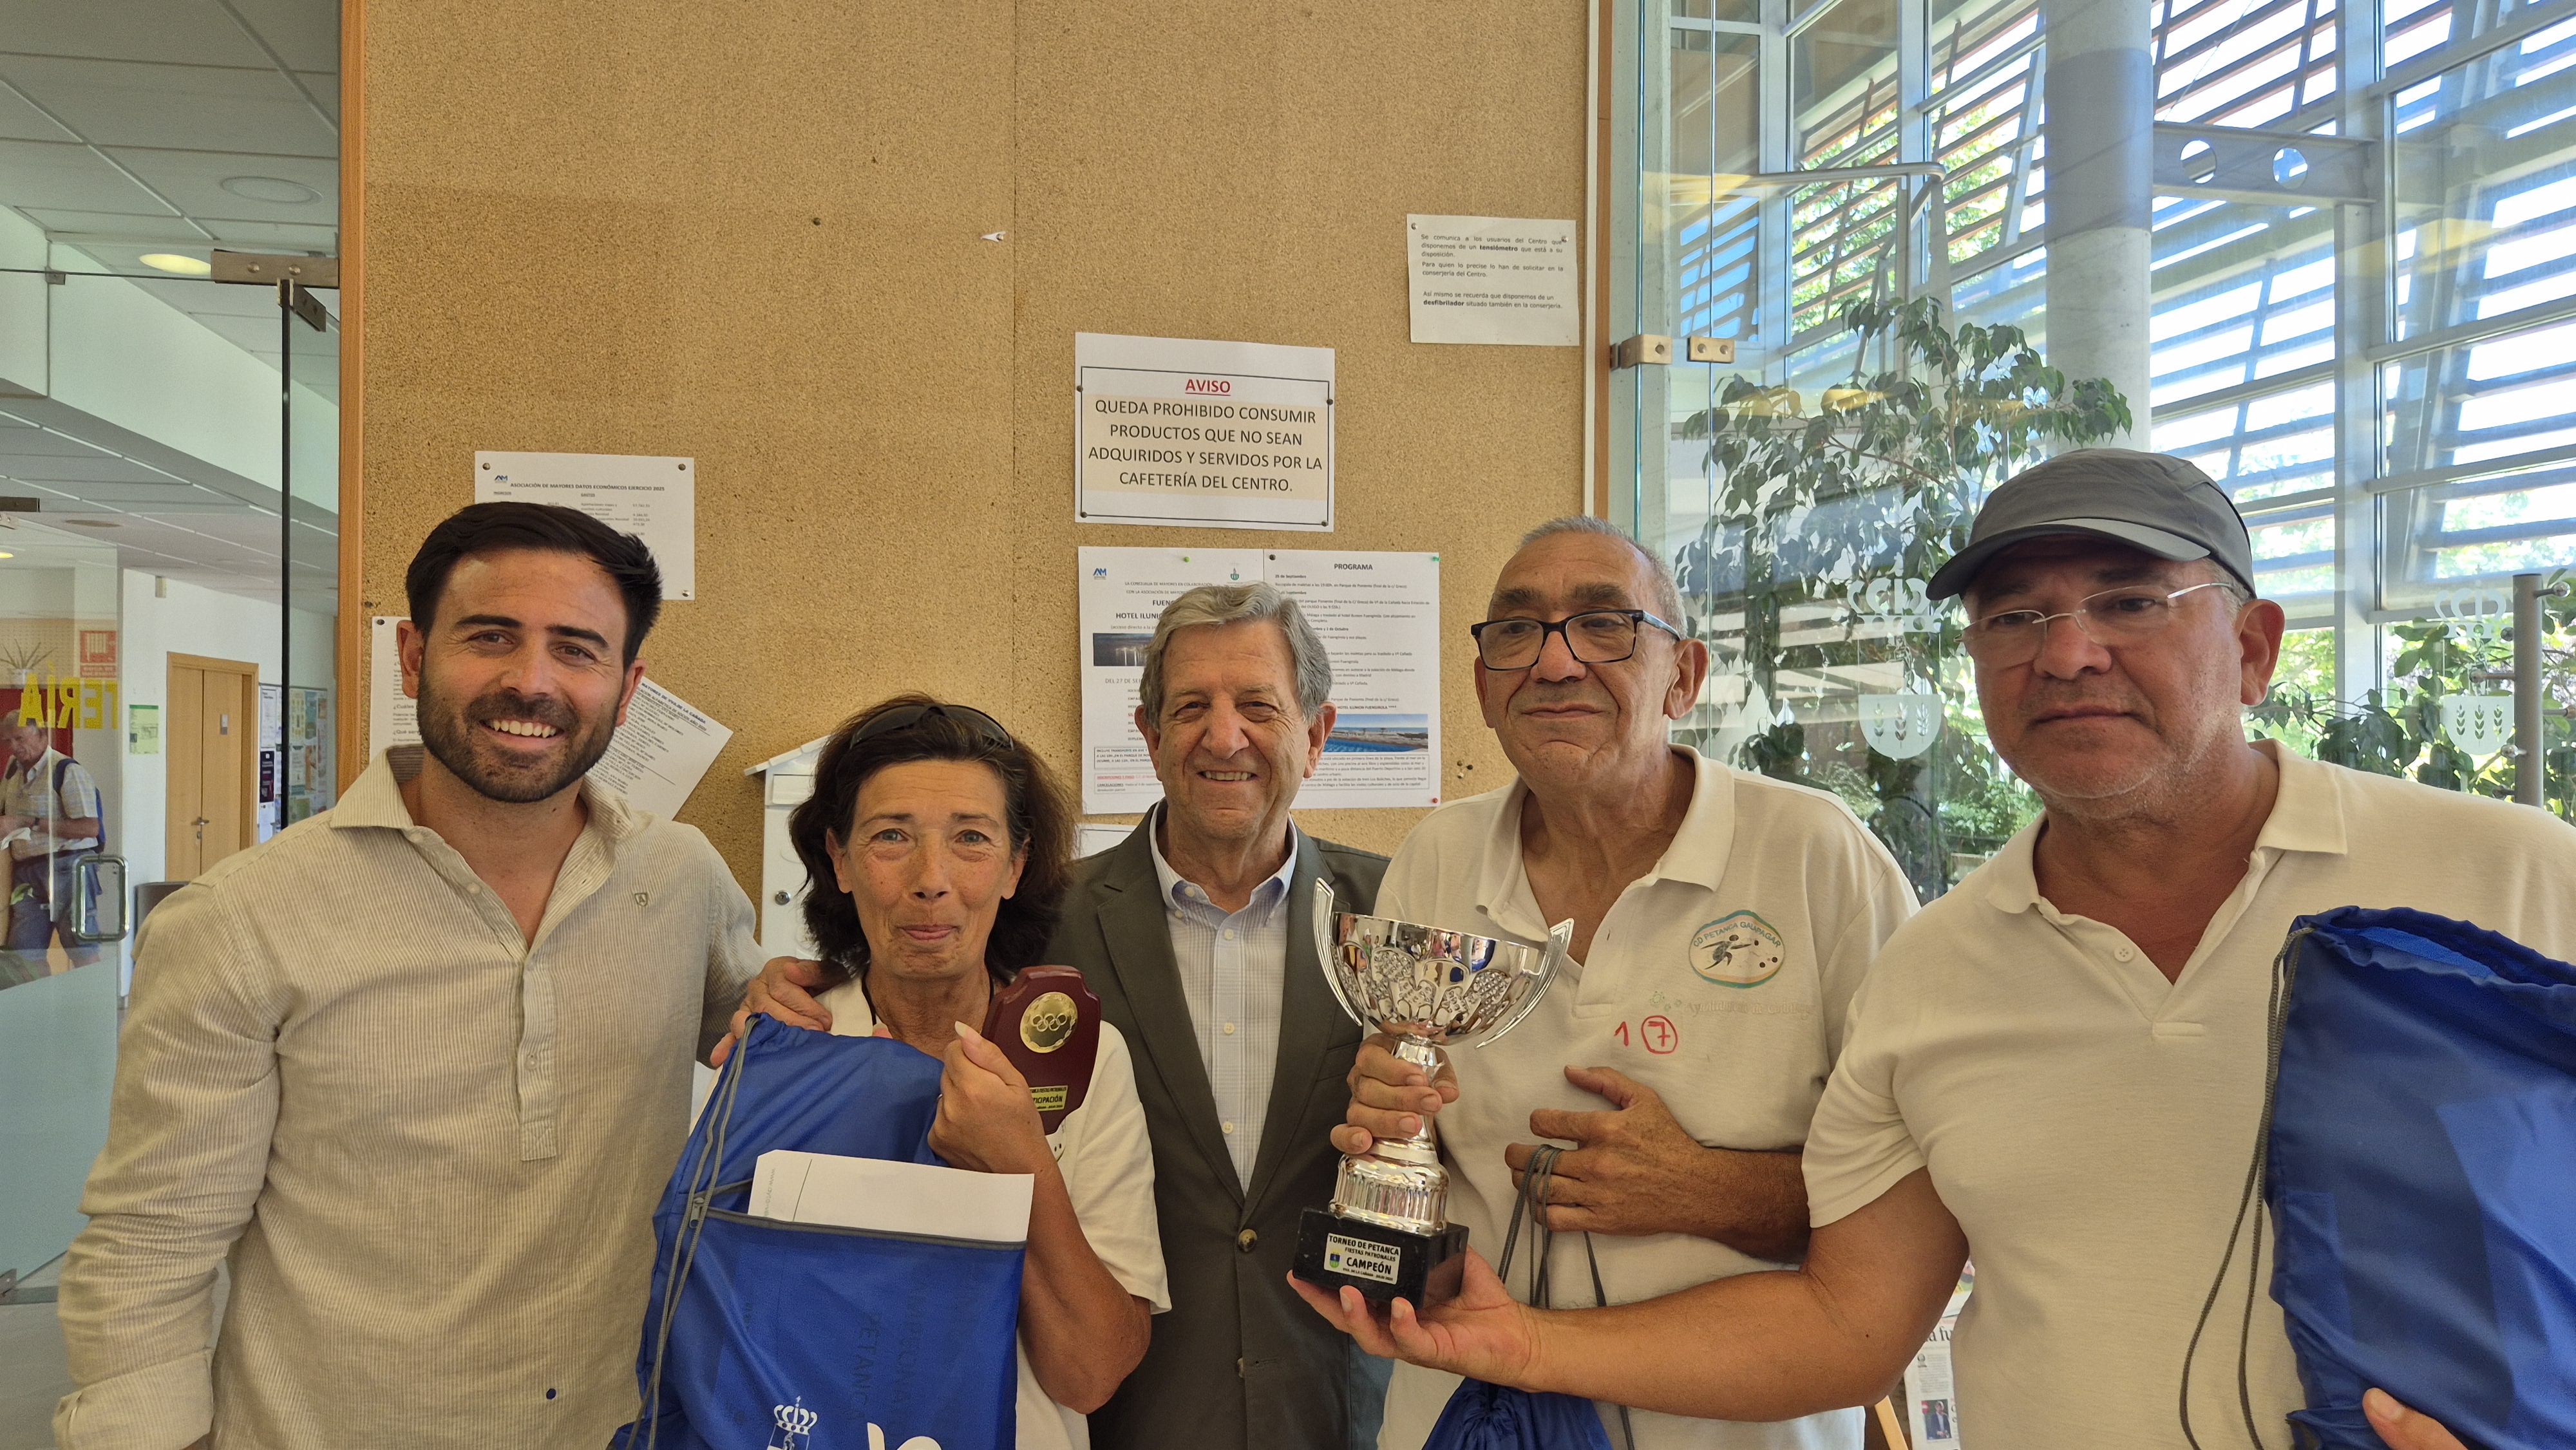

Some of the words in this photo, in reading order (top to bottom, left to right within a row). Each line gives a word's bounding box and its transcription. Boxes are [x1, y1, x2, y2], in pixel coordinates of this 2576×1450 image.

[1185, 379, 1231, 393] AVISO
[1095, 399, 1148, 415] QUEDA
[1153, 402, 1235, 419] PROHIBIDO
[1239, 407, 1316, 424] CONSUMIR
[1110, 424, 1200, 441] PRODUCTOS
[1205, 428, 1235, 444] QUE
[1240, 430, 1262, 444] NO
[1266, 432, 1302, 446] SEAN
[1088, 446, 1182, 464] ADQUIRIDOS
[1187, 451, 1195, 464] Y
[1199, 451, 1269, 468] SERVIDOS
[1273, 455, 1302, 469] POR
[1306, 457, 1322, 470] LA
[1119, 472, 1197, 487] CAFETERÍA
[1202, 475, 1227, 489] DEL
[1232, 476, 1293, 493] CENTRO.
[1693, 936, 1703, 948] CD
[1703, 922, 1738, 941] PETANCA
[1739, 921, 1781, 948] GALAPAGAR
[1329, 1235, 1356, 1247] TORNEO
[1358, 1241, 1367, 1249] DE
[1368, 1243, 1399, 1256] PETANCA
[1345, 1247, 1364, 1256] FIESTAS
[1364, 1250, 1396, 1262] PATRONALES
[1346, 1256, 1392, 1275] CAMPEÓN
